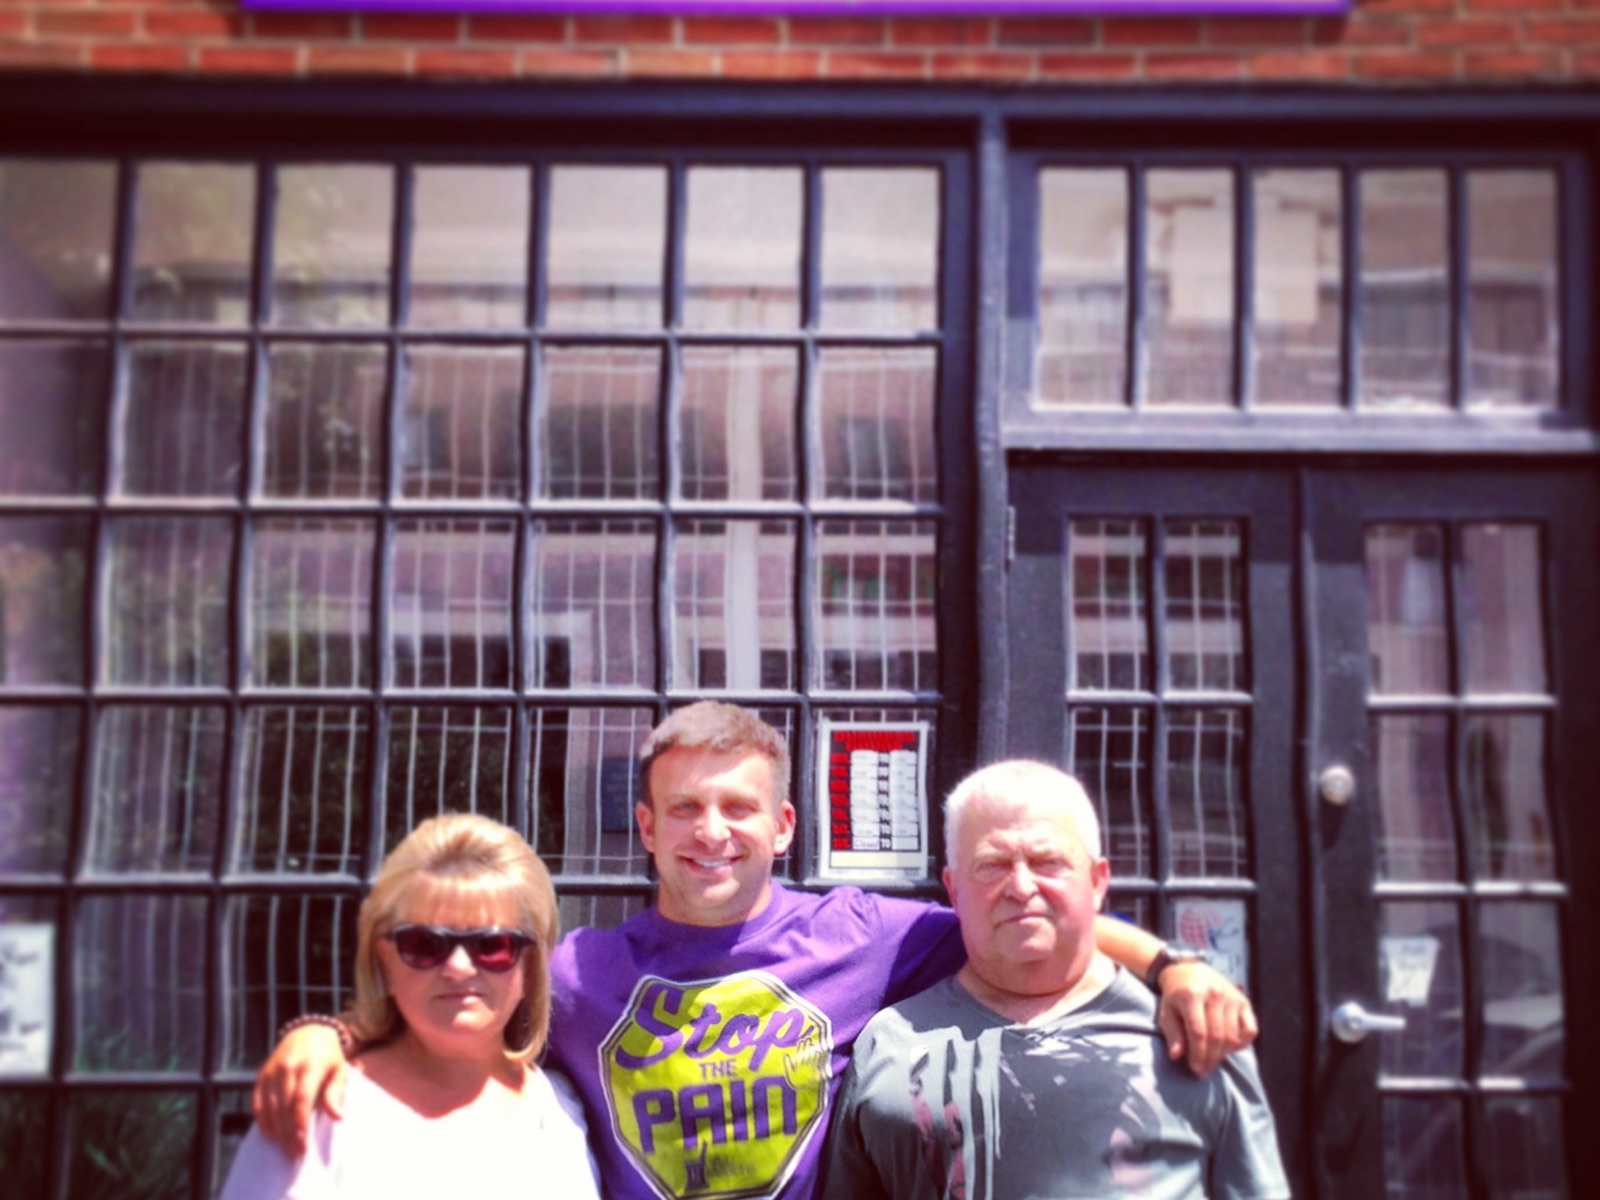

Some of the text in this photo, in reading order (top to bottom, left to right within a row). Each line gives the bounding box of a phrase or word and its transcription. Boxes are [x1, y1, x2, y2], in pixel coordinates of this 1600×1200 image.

[614, 982, 814, 1071] Stop
[699, 1058, 738, 1079] THE
[632, 1075, 797, 1155] PAIN
